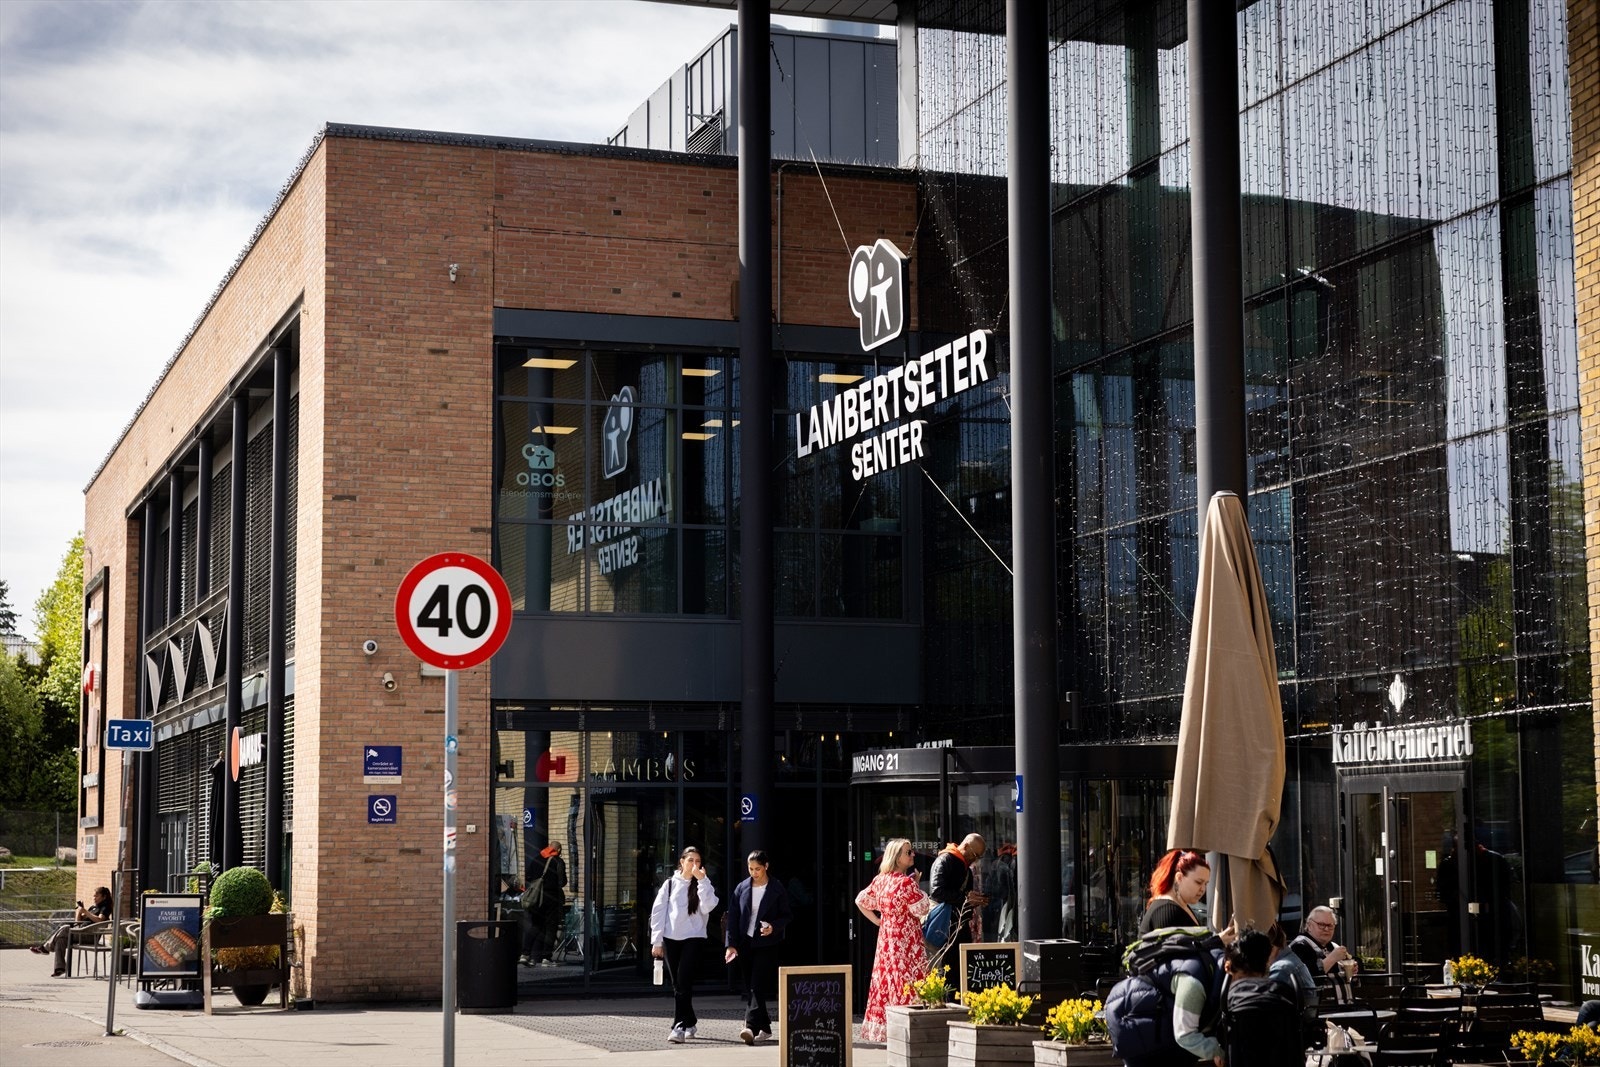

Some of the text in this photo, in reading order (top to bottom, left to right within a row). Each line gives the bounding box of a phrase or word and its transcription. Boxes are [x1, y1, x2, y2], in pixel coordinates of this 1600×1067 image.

[796, 329, 989, 459] LAMBERTSETER
[851, 419, 925, 481] SENTER
[516, 472, 566, 487] OBOS
[417, 583, 491, 639] 40
[111, 725, 150, 742] Taxi
[1331, 720, 1474, 764] Kaffebrenneriet
[886, 753, 899, 770] 21
